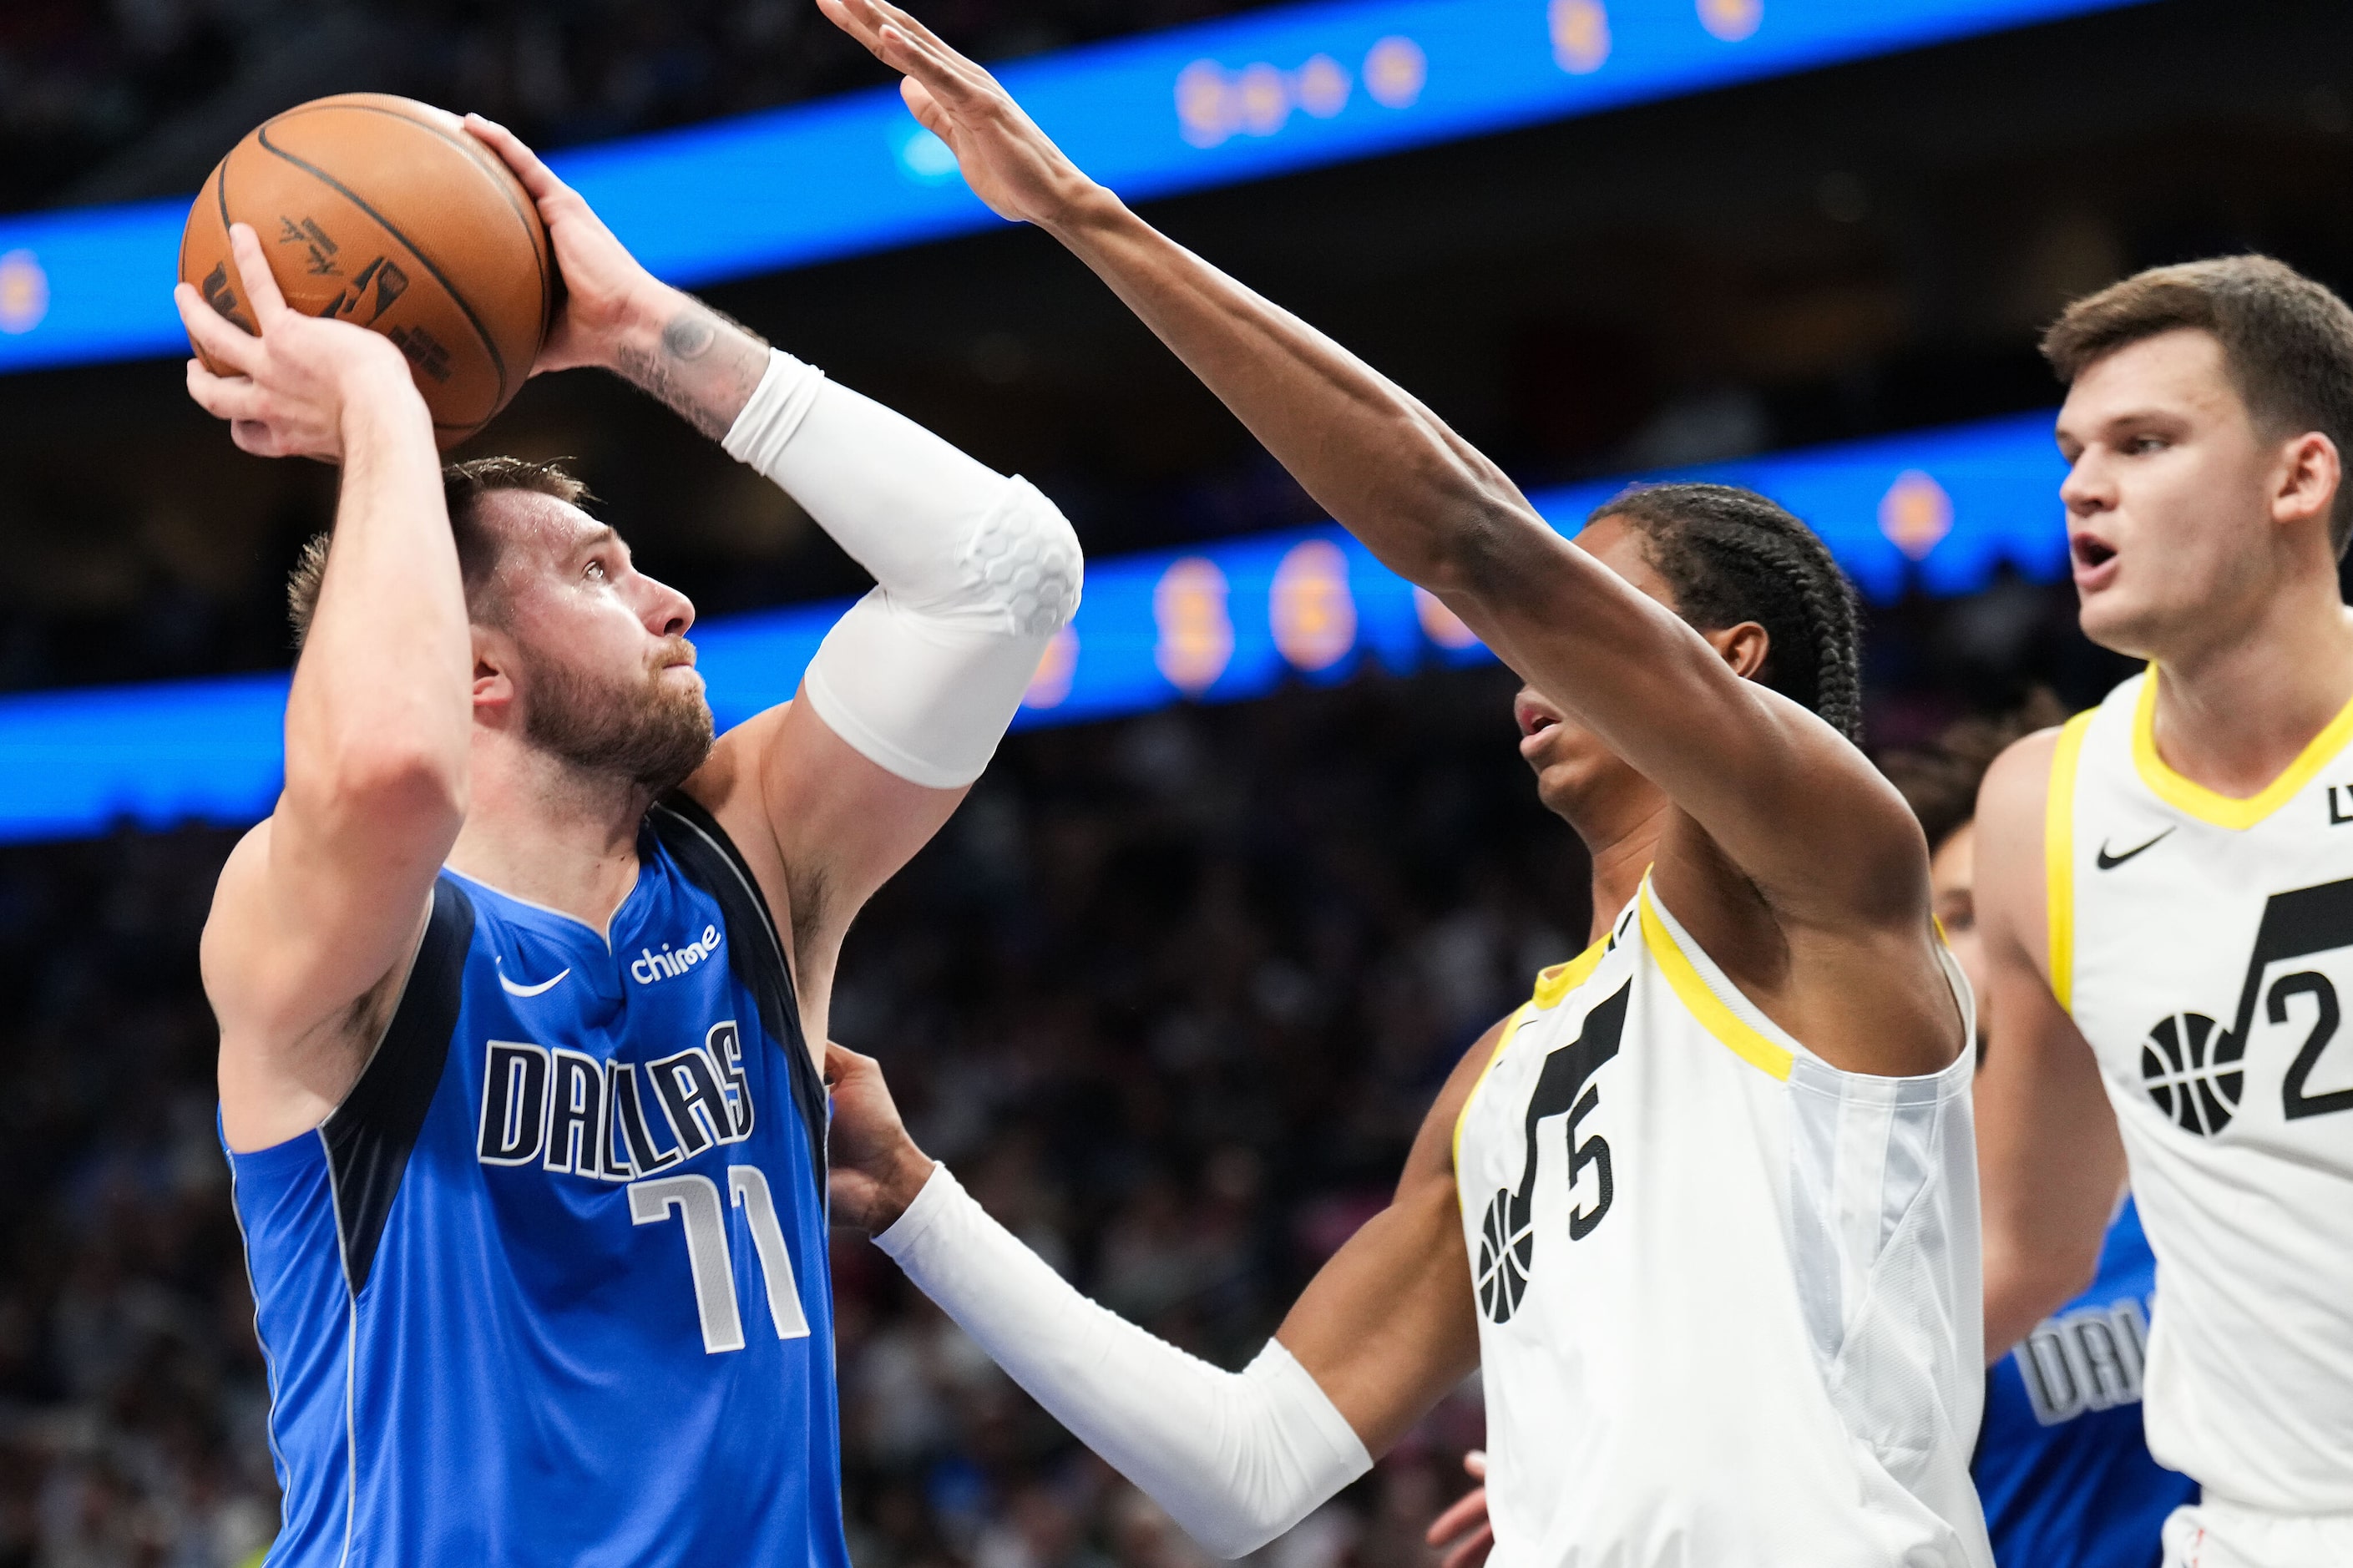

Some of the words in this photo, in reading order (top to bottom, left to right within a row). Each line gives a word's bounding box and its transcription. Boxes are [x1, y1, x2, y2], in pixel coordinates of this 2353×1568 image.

[630, 923, 721, 985] chime
[478, 1019, 755, 1182] DALLAS
[2265, 971, 2353, 1122] 2
[1566, 1082, 1613, 1242] 5
[626, 1164, 811, 1354] 77
[2011, 1292, 2154, 1427] DAL
